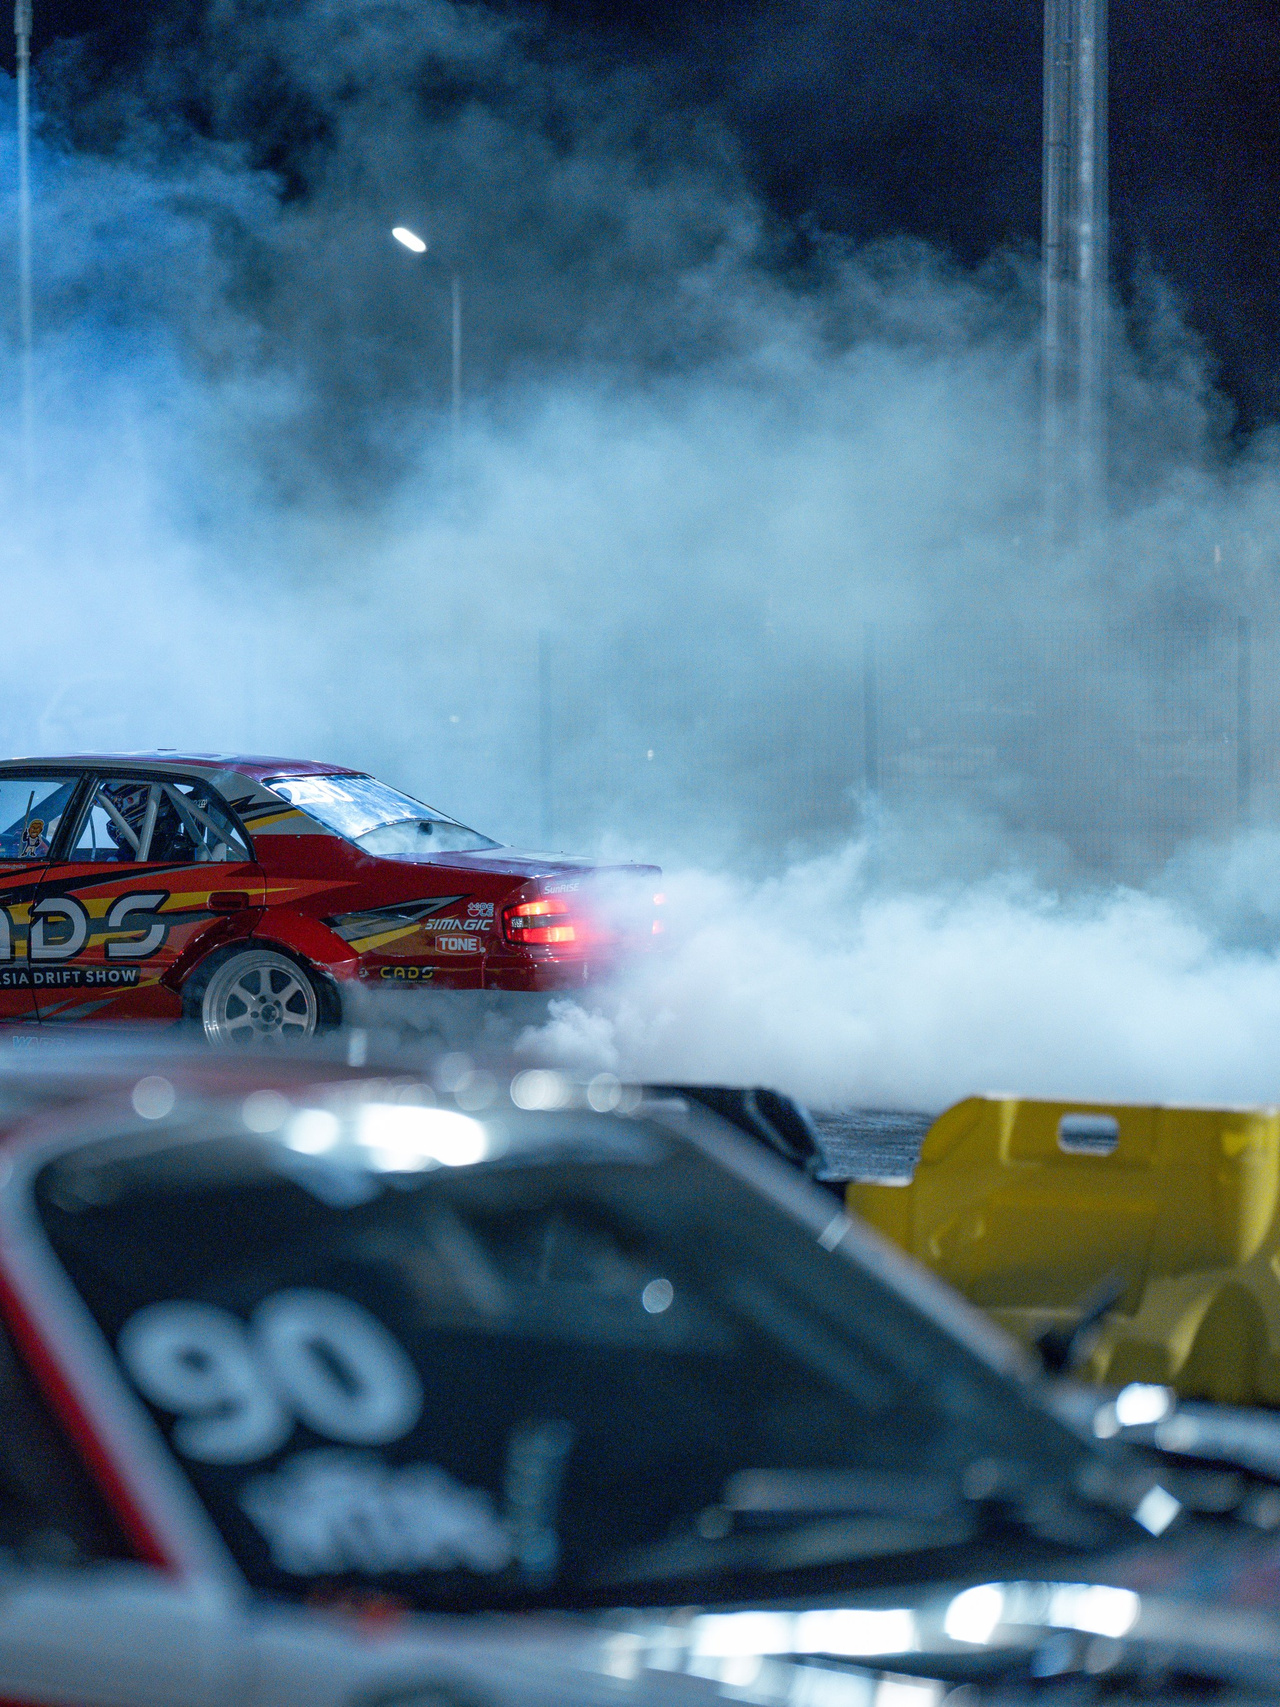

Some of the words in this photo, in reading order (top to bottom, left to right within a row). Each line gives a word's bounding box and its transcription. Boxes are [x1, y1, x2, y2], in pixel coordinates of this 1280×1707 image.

[543, 883, 580, 894] SunRISE
[425, 919, 493, 930] SIMAGIC
[439, 937, 477, 951] TONE
[33, 970, 81, 984] DRIFT
[86, 969, 138, 983] SHOW
[380, 966, 433, 979] CADS
[120, 1287, 424, 1466] 90
